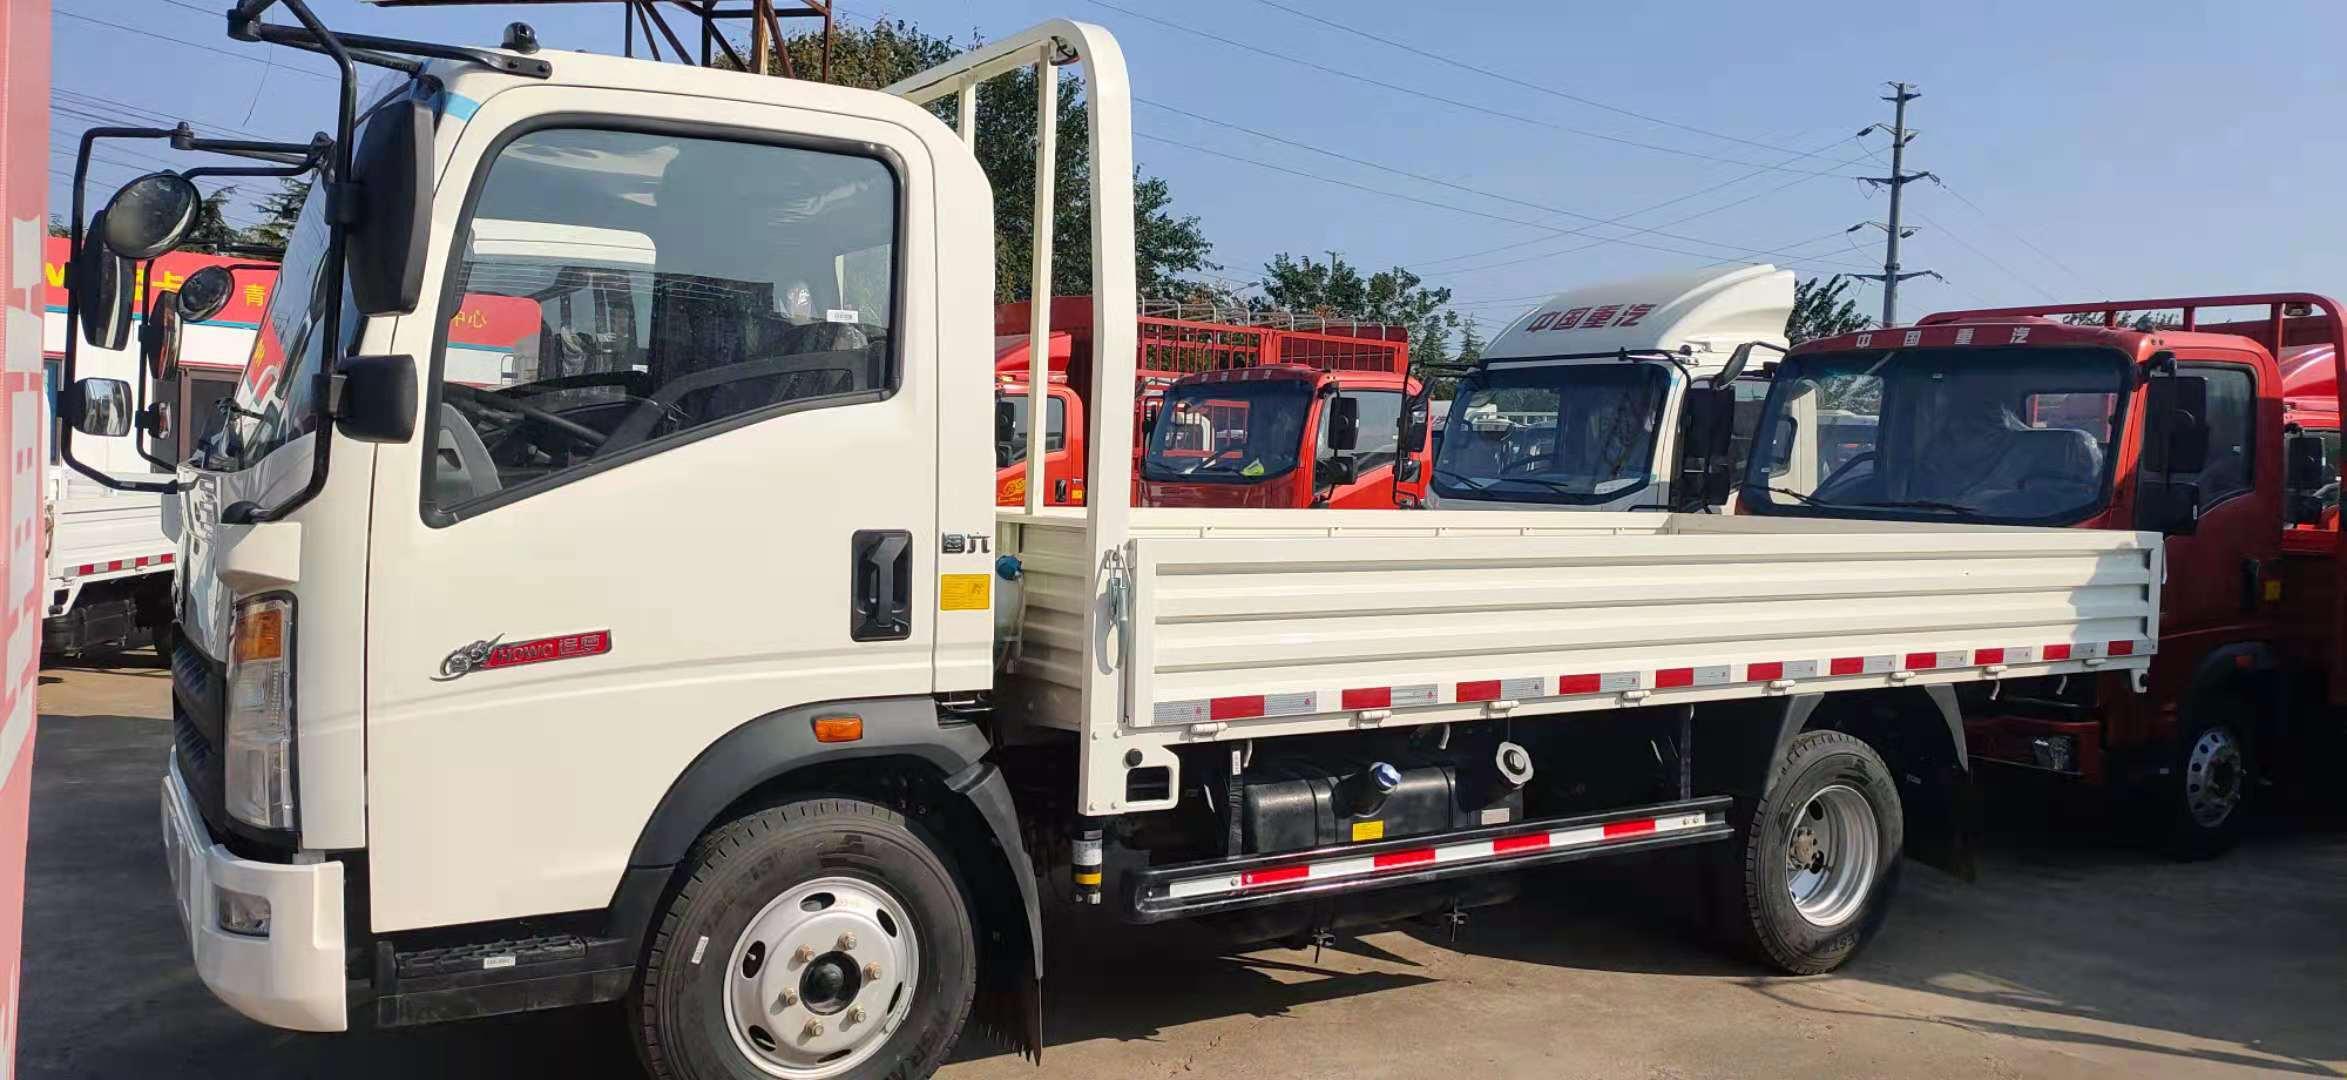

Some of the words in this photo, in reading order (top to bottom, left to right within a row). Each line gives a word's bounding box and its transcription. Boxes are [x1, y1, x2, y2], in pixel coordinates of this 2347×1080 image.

[1526, 304, 1657, 332] 中国重汽
[1856, 326, 2031, 349] 中国重汽
